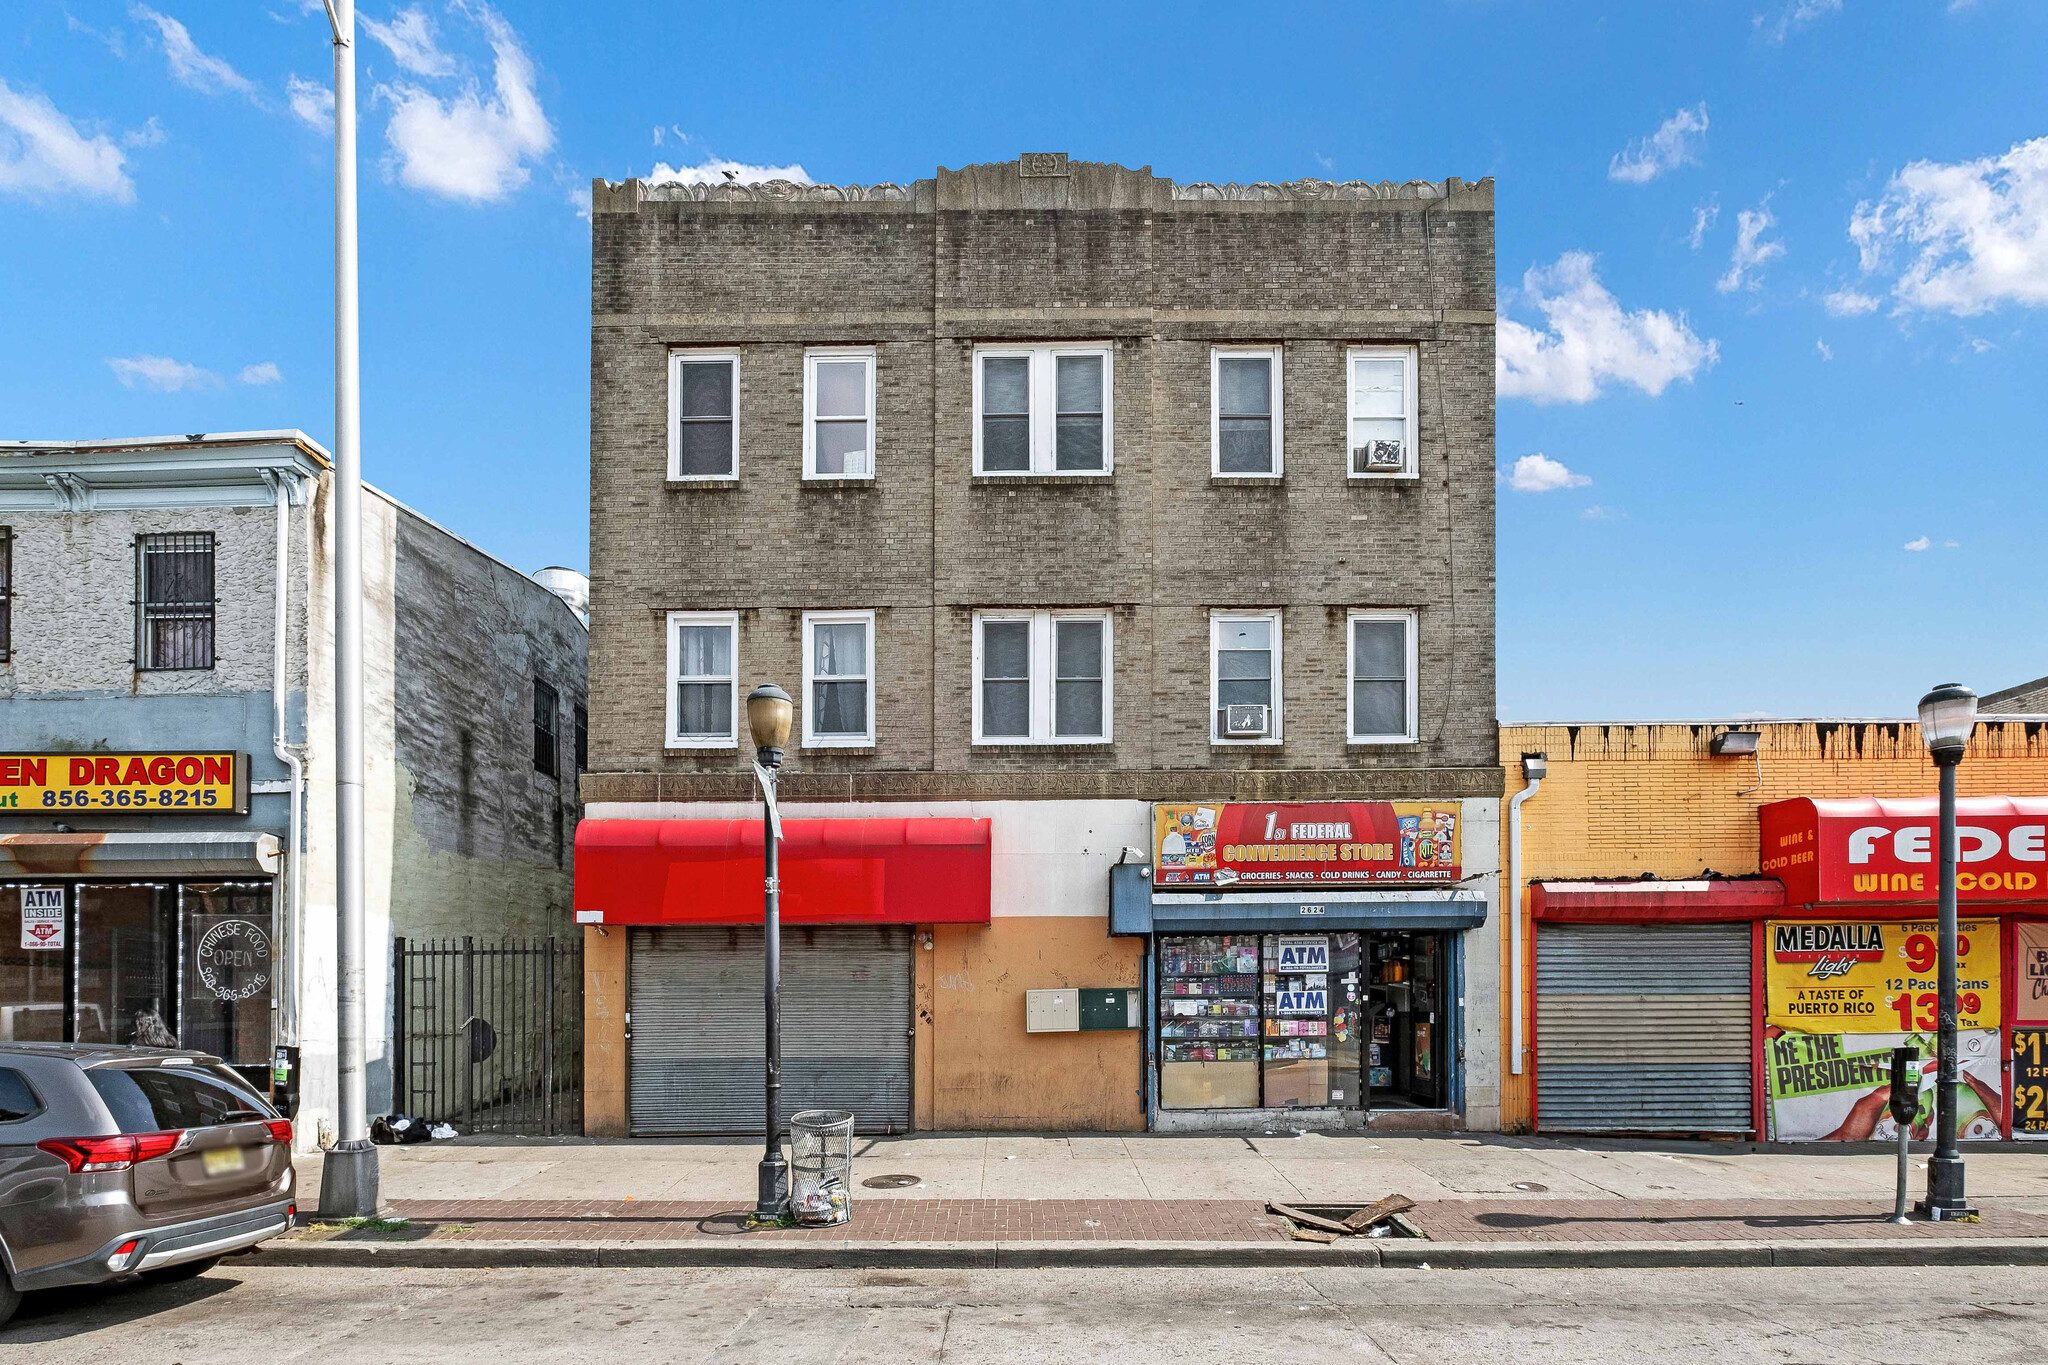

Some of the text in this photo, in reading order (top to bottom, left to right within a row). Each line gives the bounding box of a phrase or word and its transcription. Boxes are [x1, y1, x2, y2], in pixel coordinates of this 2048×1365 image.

[0, 757, 231, 786] EN DRAGON
[42, 789, 217, 807] 856-365-8215
[1290, 822, 1352, 841] FEDERAL
[1780, 829, 1814, 848] WINE &
[1223, 843, 1337, 862] CONVENIENCE
[1340, 843, 1394, 861] STORE
[1419, 843, 1433, 858] RITZ
[1848, 824, 2046, 864] FEDE
[1762, 851, 1814, 871] COLD BEER
[1320, 871, 1341, 879] COLD
[1342, 871, 1369, 879] DRINKS
[1376, 871, 1401, 879] CANDY
[1407, 870, 1452, 879] CIGARRETTE
[1853, 872, 2037, 892] WINE COLD
[25, 891, 62, 907] ATM
[25, 909, 62, 918] INSIDE
[35, 927, 53, 936] ATM
[1911, 922, 1937, 932] Pack
[201, 923, 268, 958] CHINESE FOOD
[1774, 924, 1885, 953] MEDALLA
[213, 949, 253, 967] OPEN
[1281, 947, 1327, 965] ATM
[2036, 950, 2048, 963] B
[1808, 955, 1858, 980] Light
[1885, 978, 1903, 990] 12
[1908, 977, 1939, 990] Pac
[1279, 991, 1325, 1009] ATM
[1797, 989, 1864, 1001] A TASTE OF
[1788, 1002, 1875, 1014] PUERTO RICO
[1960, 1018, 1979, 1027] Tax
[1802, 1033, 1841, 1062] THE
[2015, 1033, 2048, 1065] $1
[2026, 1067, 2040, 1077] 12
[2015, 1085, 2048, 1118] $2
[2025, 1120, 2036, 1131] 24
